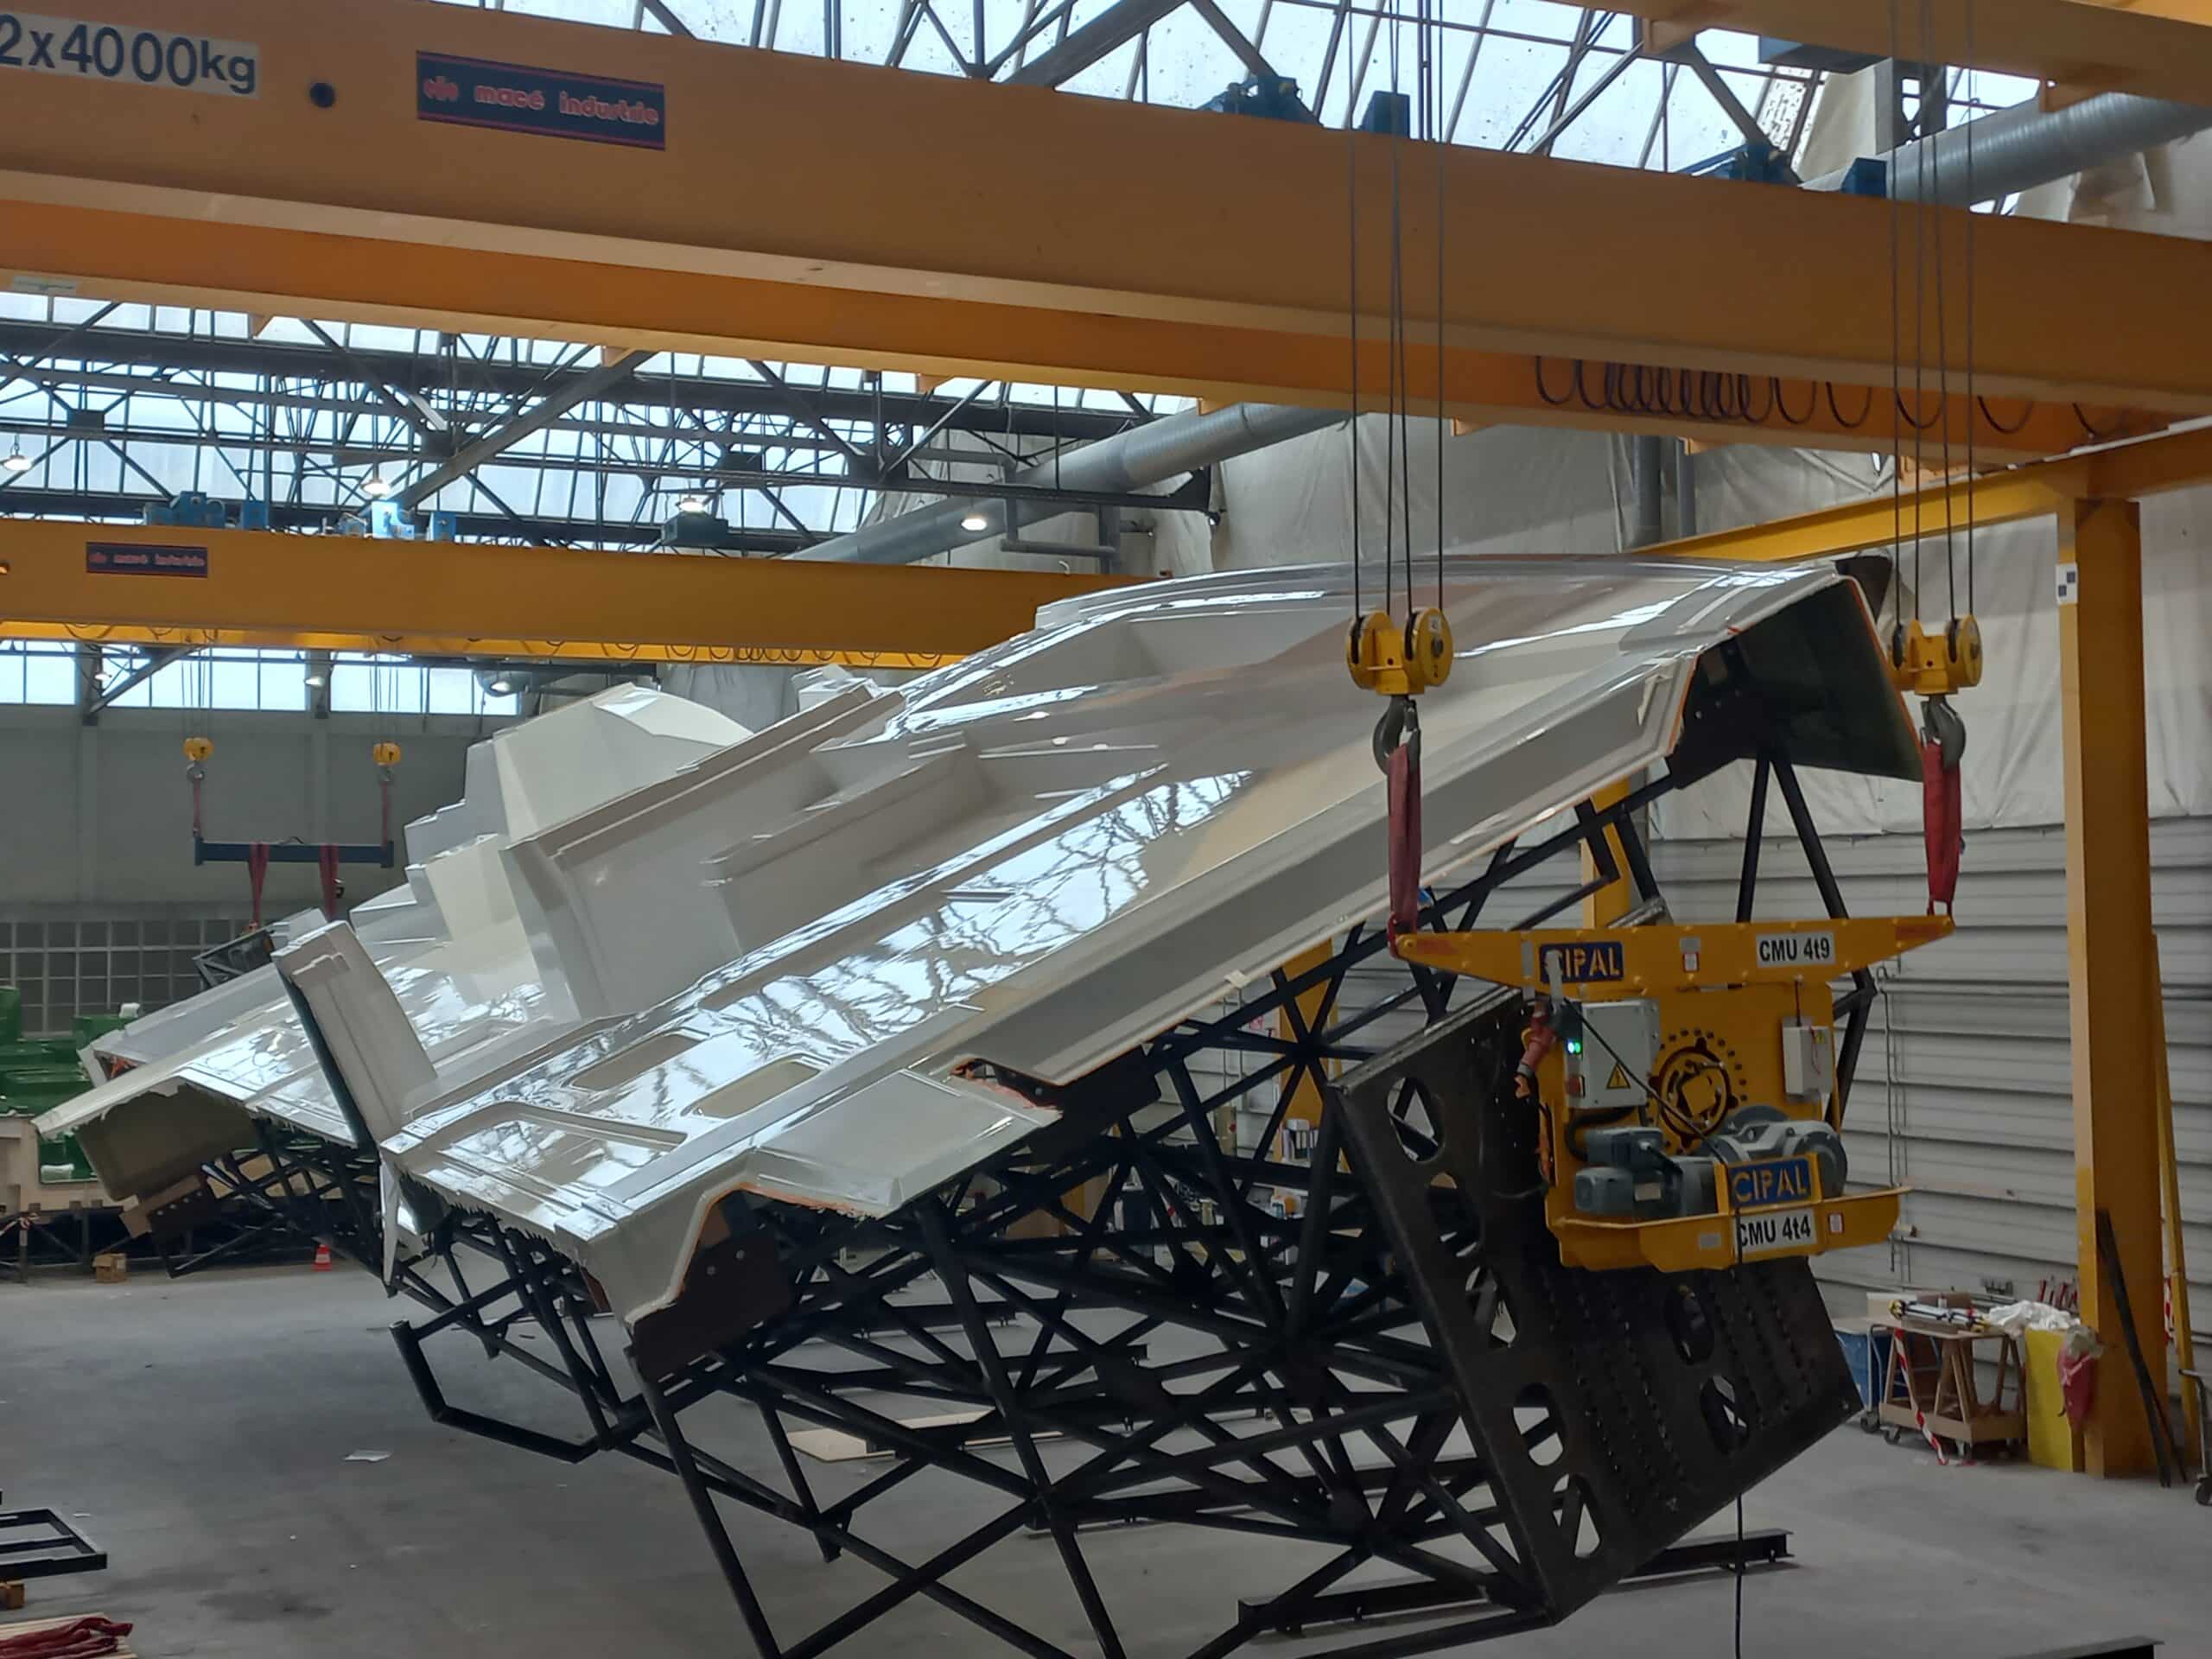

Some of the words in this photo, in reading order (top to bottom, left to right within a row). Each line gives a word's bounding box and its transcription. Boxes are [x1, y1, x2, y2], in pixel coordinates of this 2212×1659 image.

[0, 14, 257, 95] 2x4000kg
[1759, 938, 1797, 962] CMU
[1803, 937, 1830, 960] 4t9
[1733, 1165, 1807, 1202] CIPAL
[1782, 1212, 1812, 1241] 4t4
